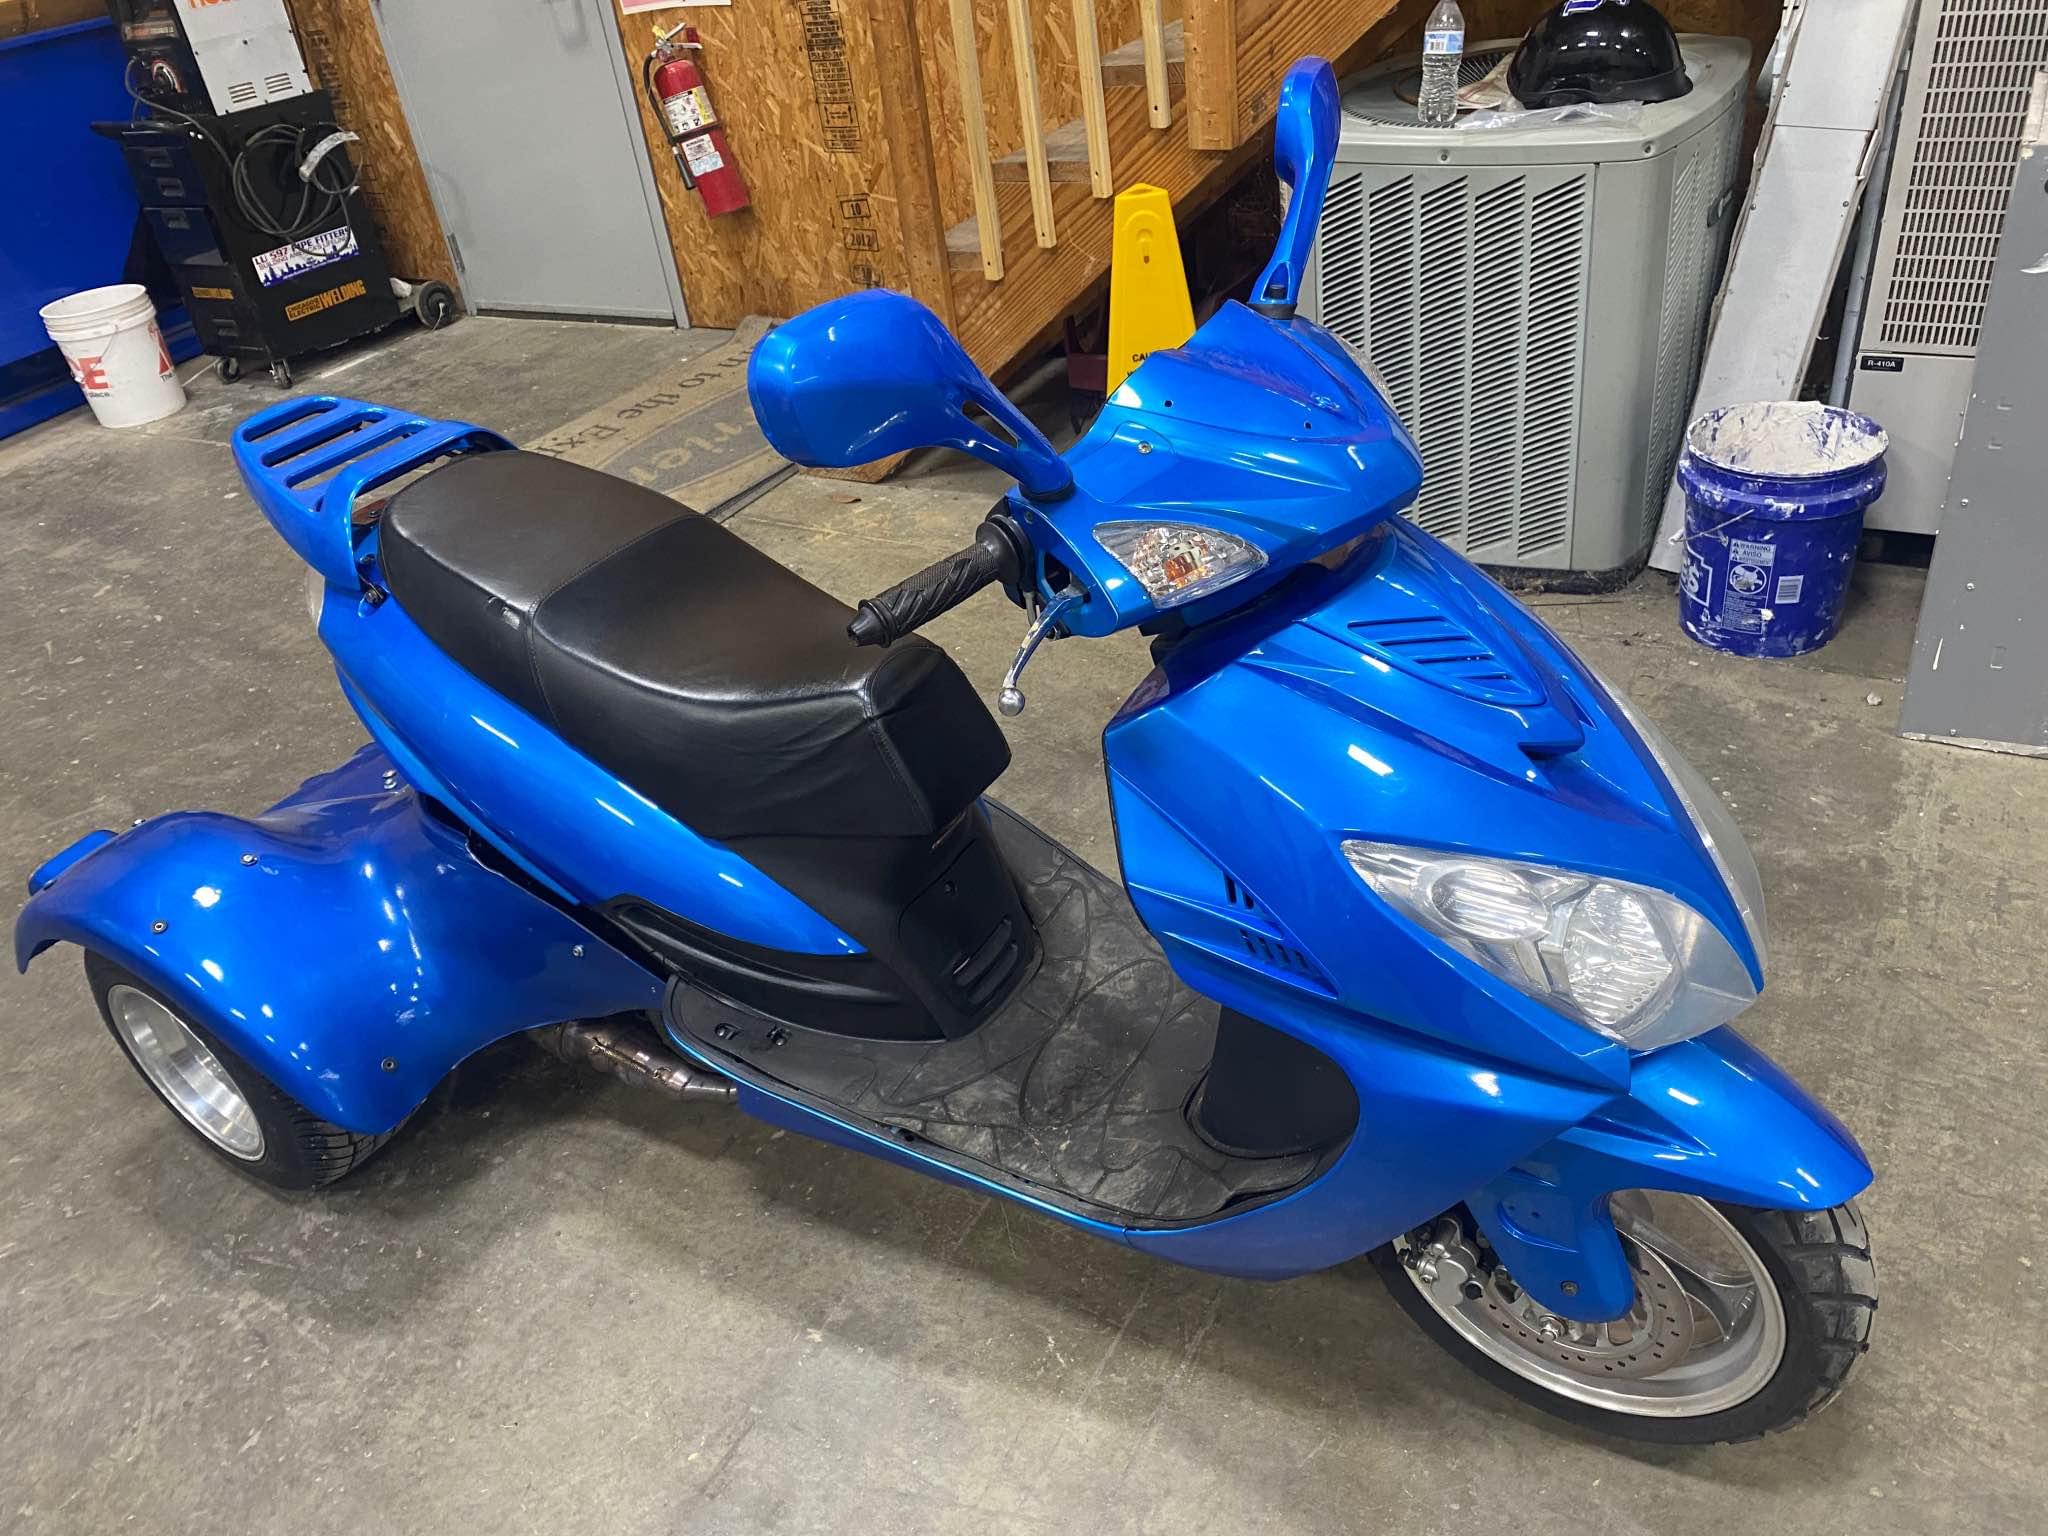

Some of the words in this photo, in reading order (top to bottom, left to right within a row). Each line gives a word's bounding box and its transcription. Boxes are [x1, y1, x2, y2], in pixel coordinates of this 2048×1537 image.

[850, 202, 862, 216] 10
[849, 231, 872, 247] 2012
[255, 256, 268, 265] LU
[270, 247, 288, 259] 597
[320, 279, 366, 308] WELDING
[288, 296, 320, 312] CHICAGO
[289, 302, 322, 318] ELECTRIC
[1867, 359, 1896, 368] R-410A
[678, 372, 722, 389] to
[617, 393, 680, 420] the
[1740, 543, 1771, 552] WARNING
[1742, 550, 1762, 559] AVISO
